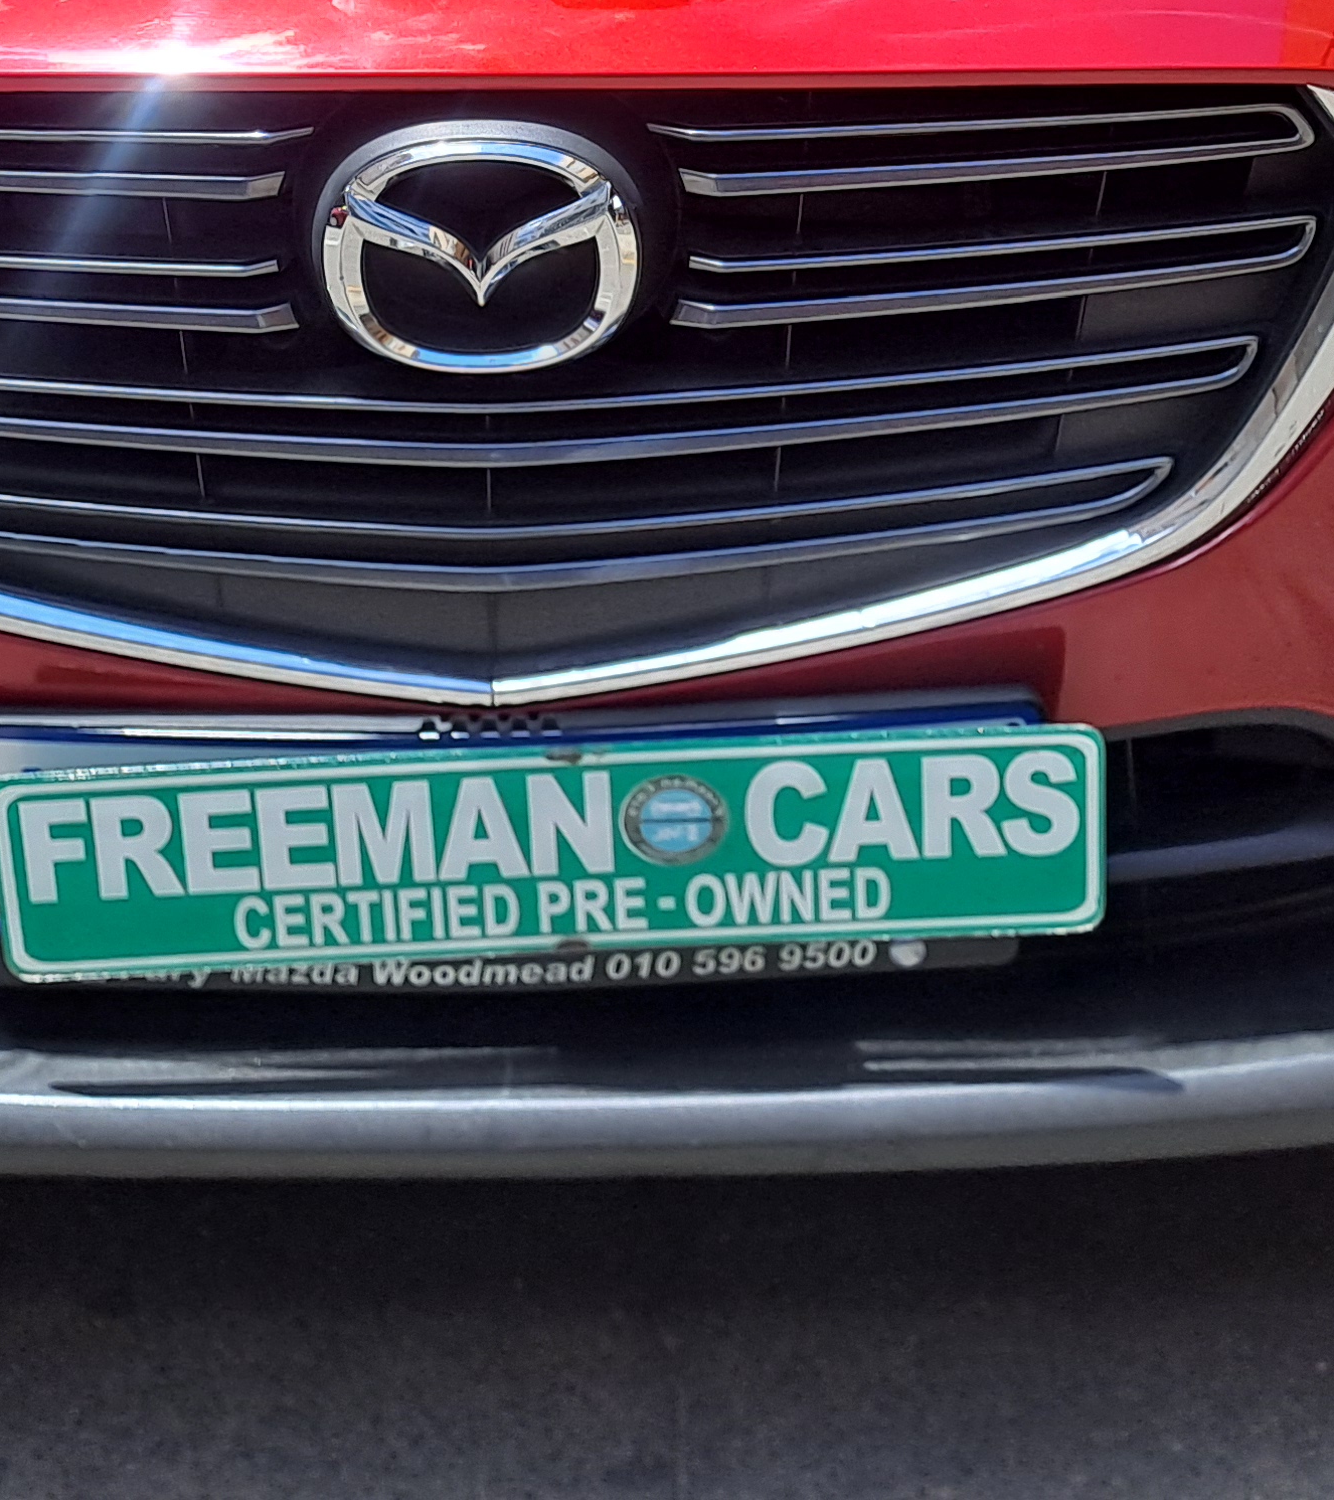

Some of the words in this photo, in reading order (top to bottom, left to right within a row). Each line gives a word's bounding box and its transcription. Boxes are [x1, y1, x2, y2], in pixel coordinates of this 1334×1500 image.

[17, 770, 615, 904] FREEMAN
[744, 750, 1081, 867] CARS
[234, 882, 521, 951] CERTIFIED
[229, 963, 360, 986] Mazda
[372, 955, 596, 987] Woodmead
[605, 950, 681, 981] 010
[692, 944, 767, 976] 596
[778, 939, 878, 972] 9500
